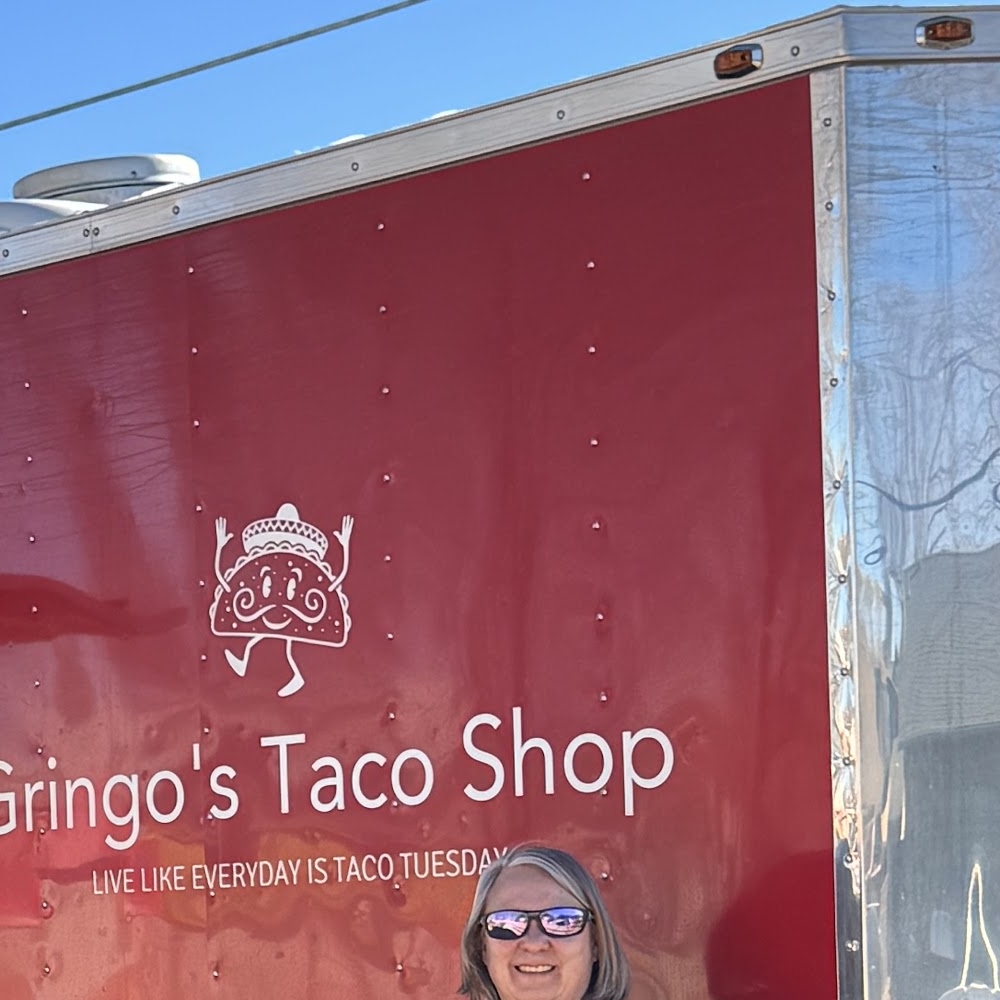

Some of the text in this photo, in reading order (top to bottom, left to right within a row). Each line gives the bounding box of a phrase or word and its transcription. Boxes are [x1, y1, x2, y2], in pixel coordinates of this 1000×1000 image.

[260, 733, 434, 814] Taco
[462, 706, 674, 817] Shop
[92, 868, 135, 895] LIVE
[141, 866, 185, 892] LIKE
[192, 859, 301, 890] EVERYDAY
[307, 857, 328, 884] IS
[333, 853, 394, 882] TACO
